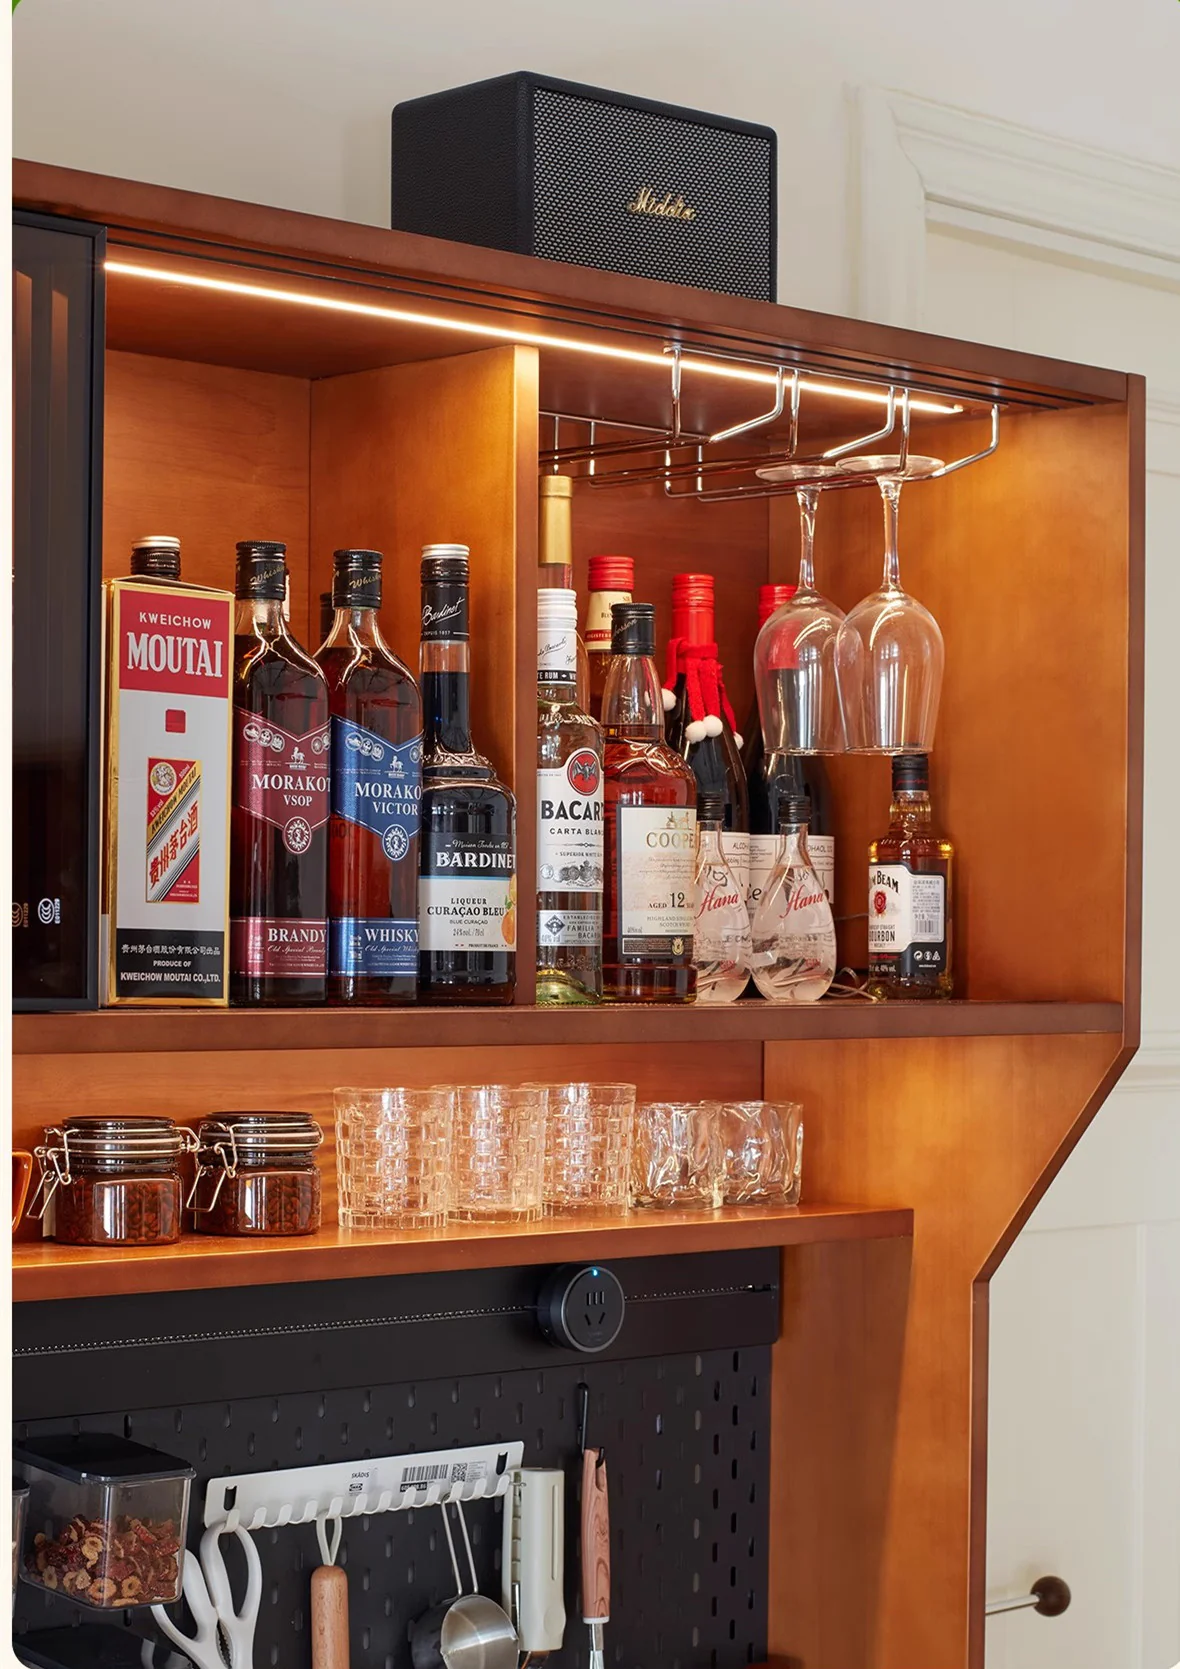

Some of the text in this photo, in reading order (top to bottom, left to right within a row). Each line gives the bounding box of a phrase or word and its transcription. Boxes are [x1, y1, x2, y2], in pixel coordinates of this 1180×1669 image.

[139, 611, 212, 630] KWEICHOW
[127, 632, 223, 678] MOUTAI
[545, 671, 559, 679] RUM
[283, 795, 313, 807] VSOP
[373, 801, 419, 816] VICTOR
[549, 827, 582, 835] CARTA
[149, 799, 198, 890] 贵州茅台酒
[436, 851, 516, 869] BARDINET
[877, 870, 900, 894] BEAM
[451, 897, 487, 906] LIQUEUR
[670, 892, 685, 908] 12
[694, 884, 739, 919] Hana
[779, 884, 824, 919] Hana
[427, 906, 505, 918] CURAÇAO BLEU
[267, 928, 327, 943] BRANDY
[364, 928, 420, 942] WHISKY
[153, 960, 192, 968] PRODUCE OF
[120, 972, 163, 981] KWEICHOW
[163, 973, 192, 982] MOUTAI
[351, 1471, 370, 1479] SKÅDIS
